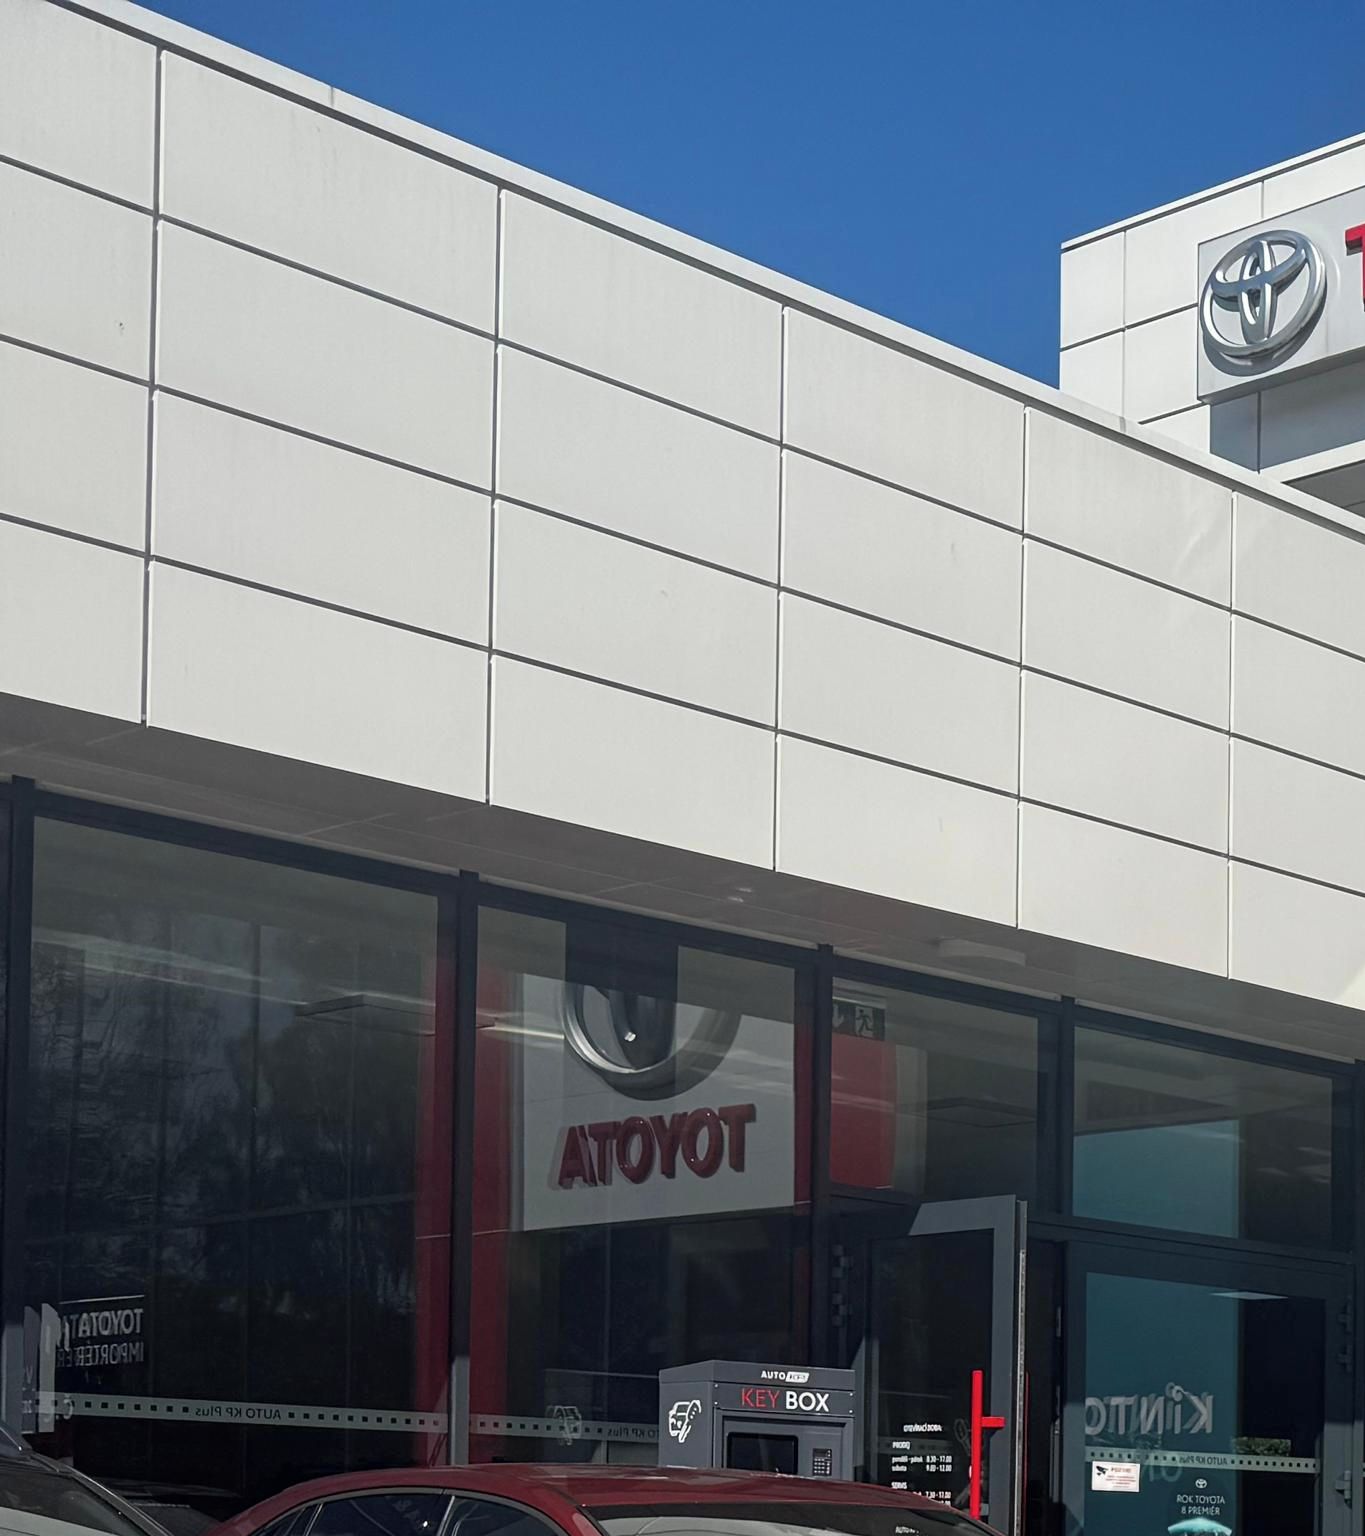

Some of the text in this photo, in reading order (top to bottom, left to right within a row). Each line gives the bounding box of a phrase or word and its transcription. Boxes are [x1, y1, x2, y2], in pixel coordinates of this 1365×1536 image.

[761, 1370, 786, 1381] AUTO
[741, 1387, 830, 1412] KEY BOX
